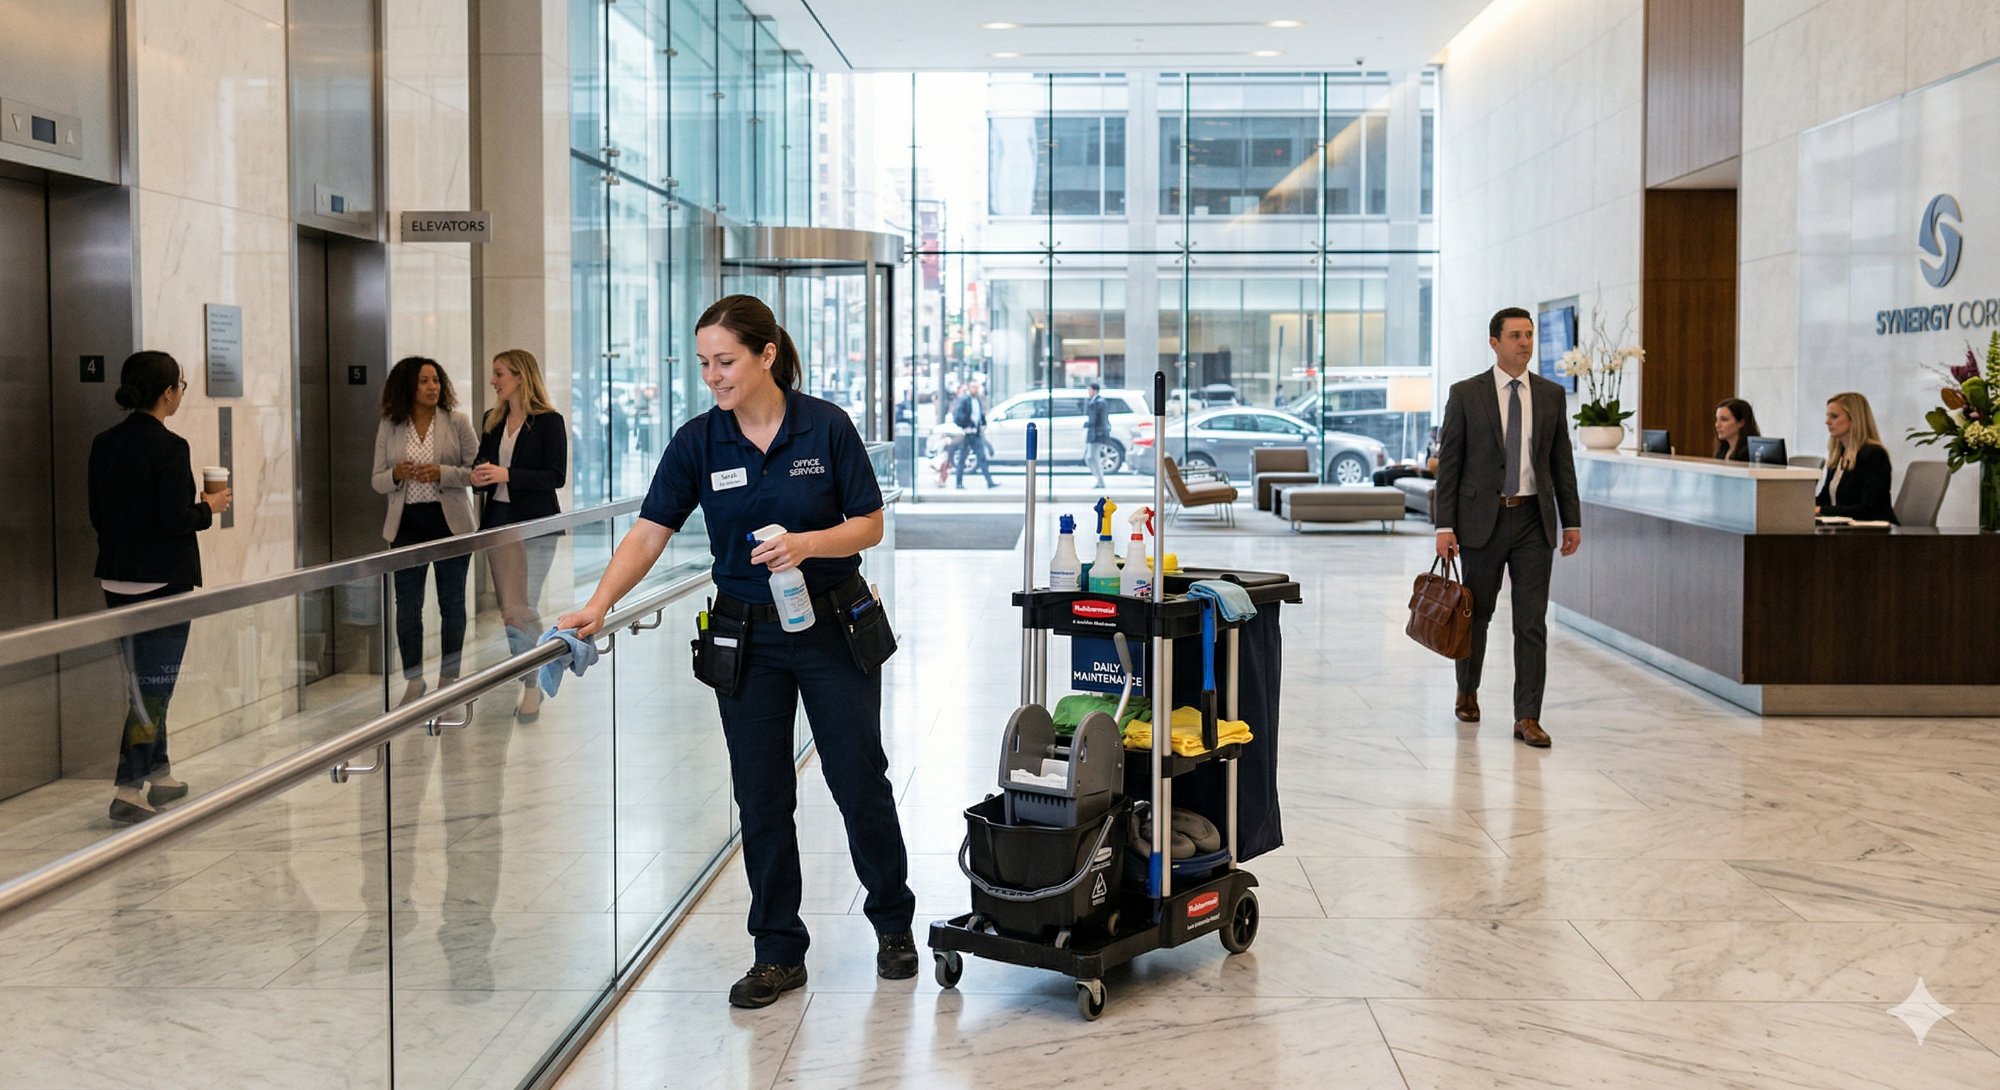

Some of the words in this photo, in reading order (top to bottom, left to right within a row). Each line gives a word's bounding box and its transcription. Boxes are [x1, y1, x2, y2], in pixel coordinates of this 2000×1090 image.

[411, 220, 485, 232] ELEVATORS
[1876, 303, 1954, 336] SYNERGY
[1957, 297, 2000, 329] COR
[87, 359, 97, 374] 4
[353, 367, 361, 380] 5
[789, 466, 826, 477] SERVICES
[1093, 661, 1121, 673] DAILY
[1073, 670, 1143, 687] MAINTENAE
